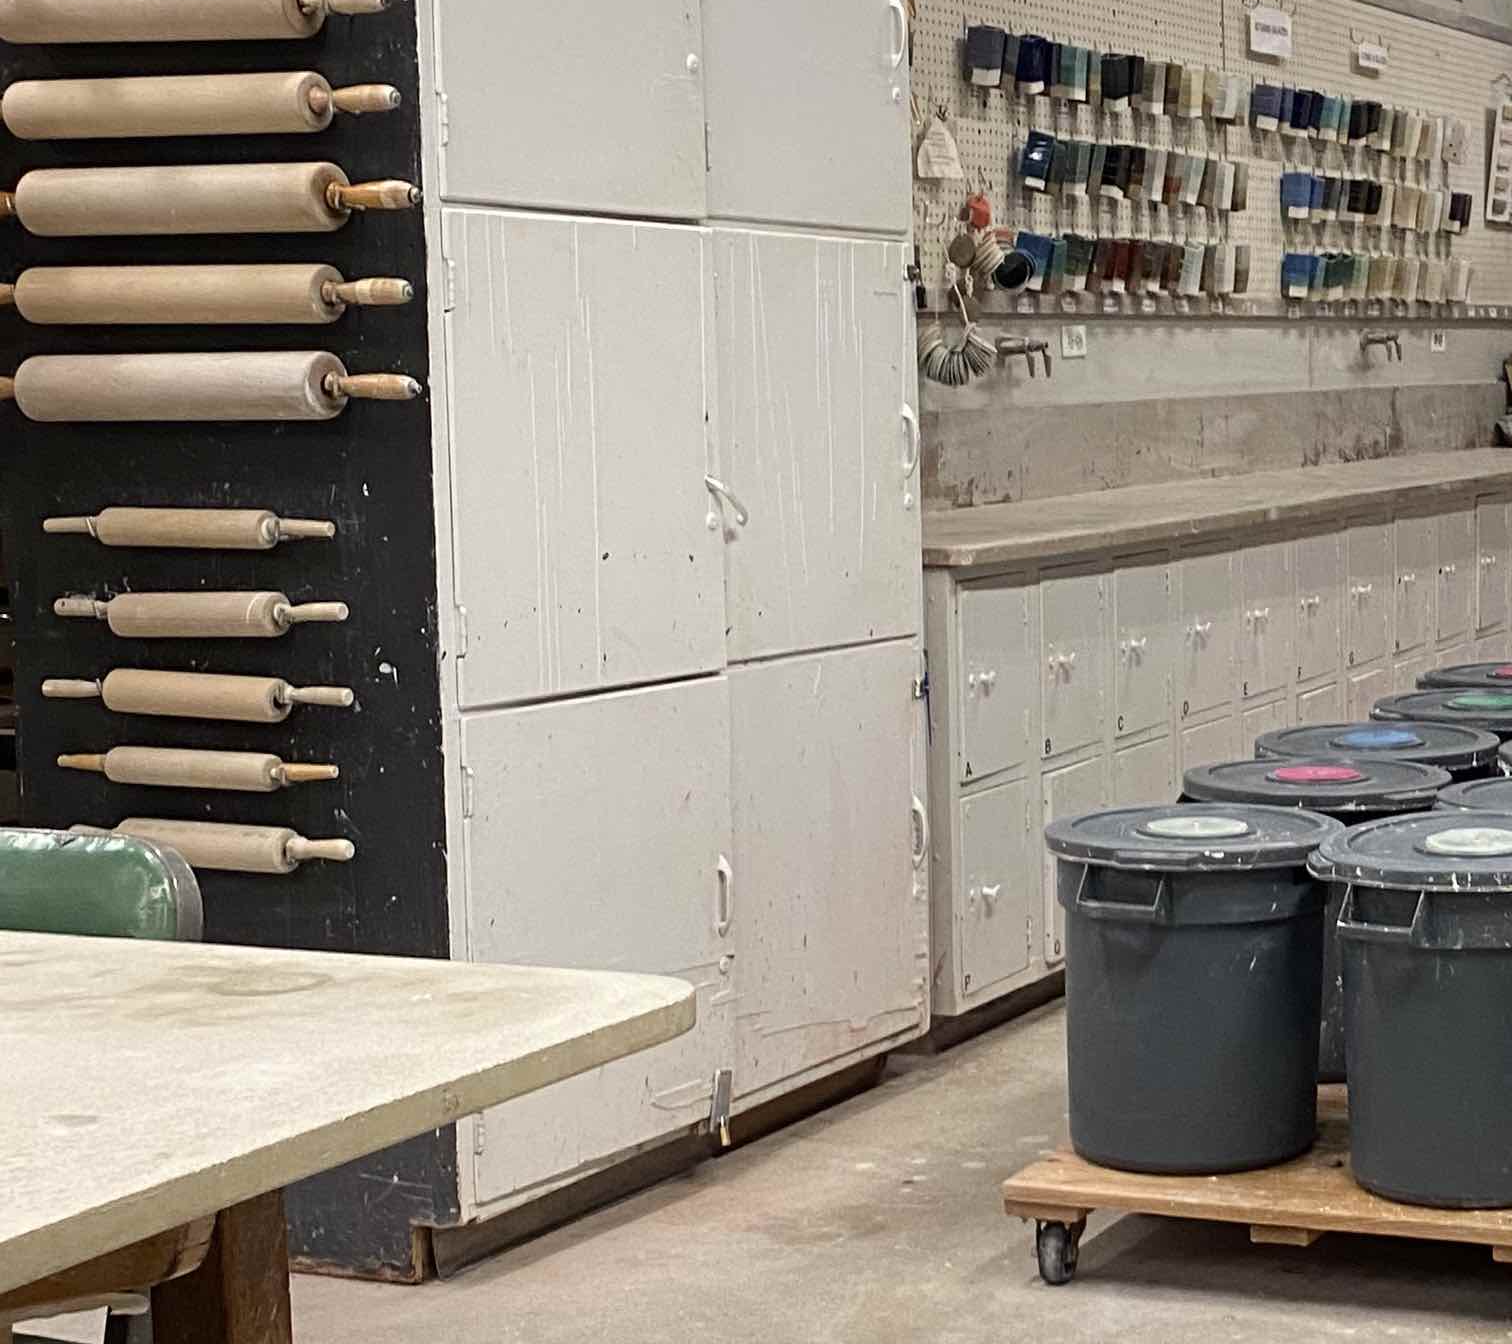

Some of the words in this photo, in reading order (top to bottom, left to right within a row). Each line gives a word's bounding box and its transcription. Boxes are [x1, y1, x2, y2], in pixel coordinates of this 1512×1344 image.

[1242, 682, 1249, 697] E
[1182, 701, 1190, 716] D
[1117, 716, 1124, 731] C
[1044, 739, 1052, 755] B
[964, 762, 973, 777] A
[964, 975, 971, 990] P
